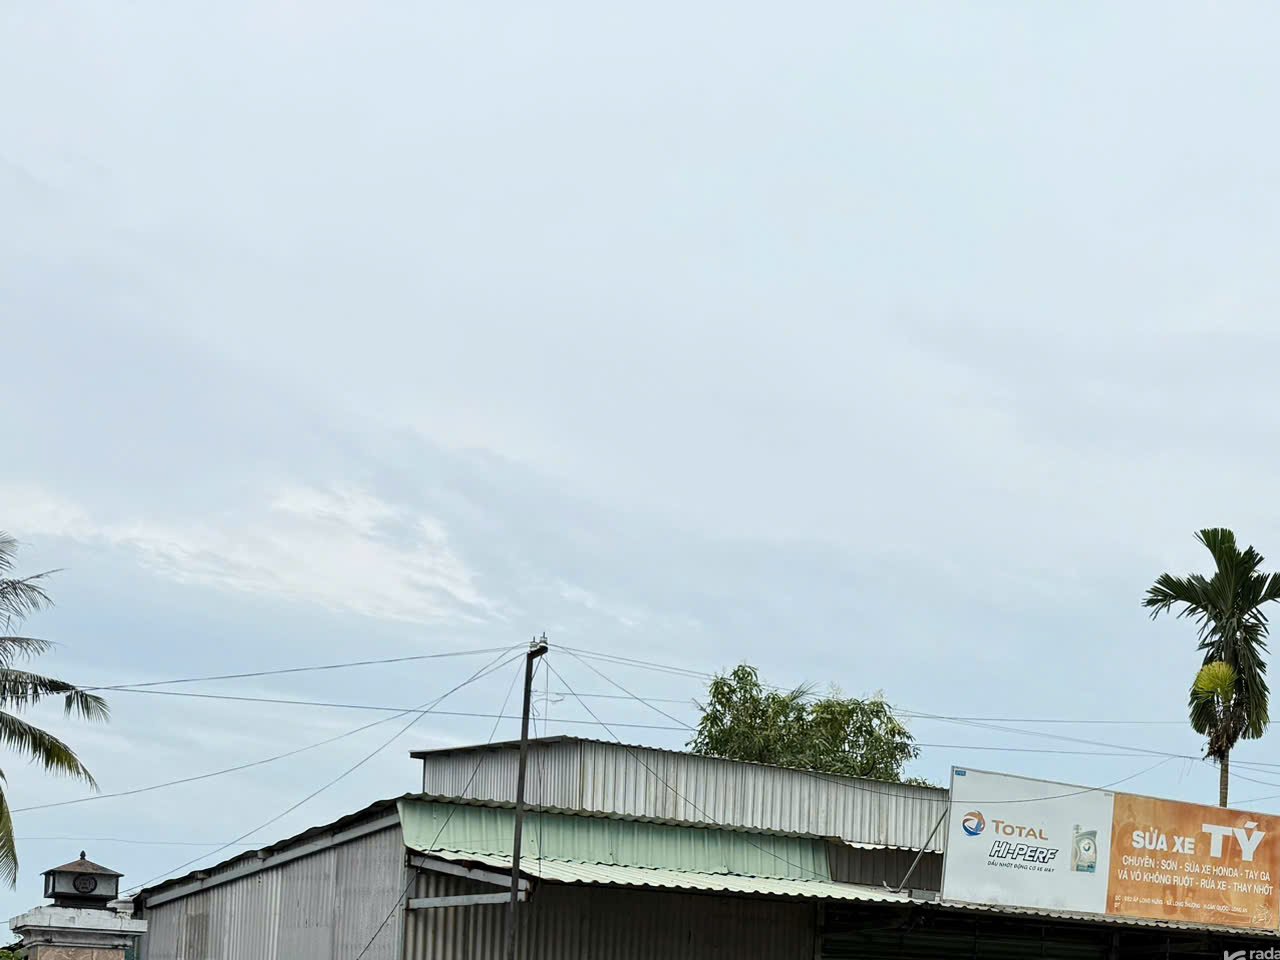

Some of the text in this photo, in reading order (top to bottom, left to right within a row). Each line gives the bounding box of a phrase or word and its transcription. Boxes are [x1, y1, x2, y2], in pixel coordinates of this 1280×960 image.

[992, 819, 1049, 840] TOTAL
[1131, 821, 1266, 862] SỬA XE TÝ
[989, 840, 1059, 864] HI-PERF
[1117, 868, 1129, 880] VÁ
[1143, 871, 1172, 885] KHÔNG
[1216, 880, 1227, 891] XE
[1233, 882, 1253, 893] THAY
[1122, 855, 1156, 868] CHUYÊN
[1160, 859, 1178, 870] SƠN
[1201, 864, 1211, 875] XE
[1212, 866, 1239, 877] HONDA
[1244, 869, 1259, 880] TAY
[1260, 871, 1271, 881] GA
